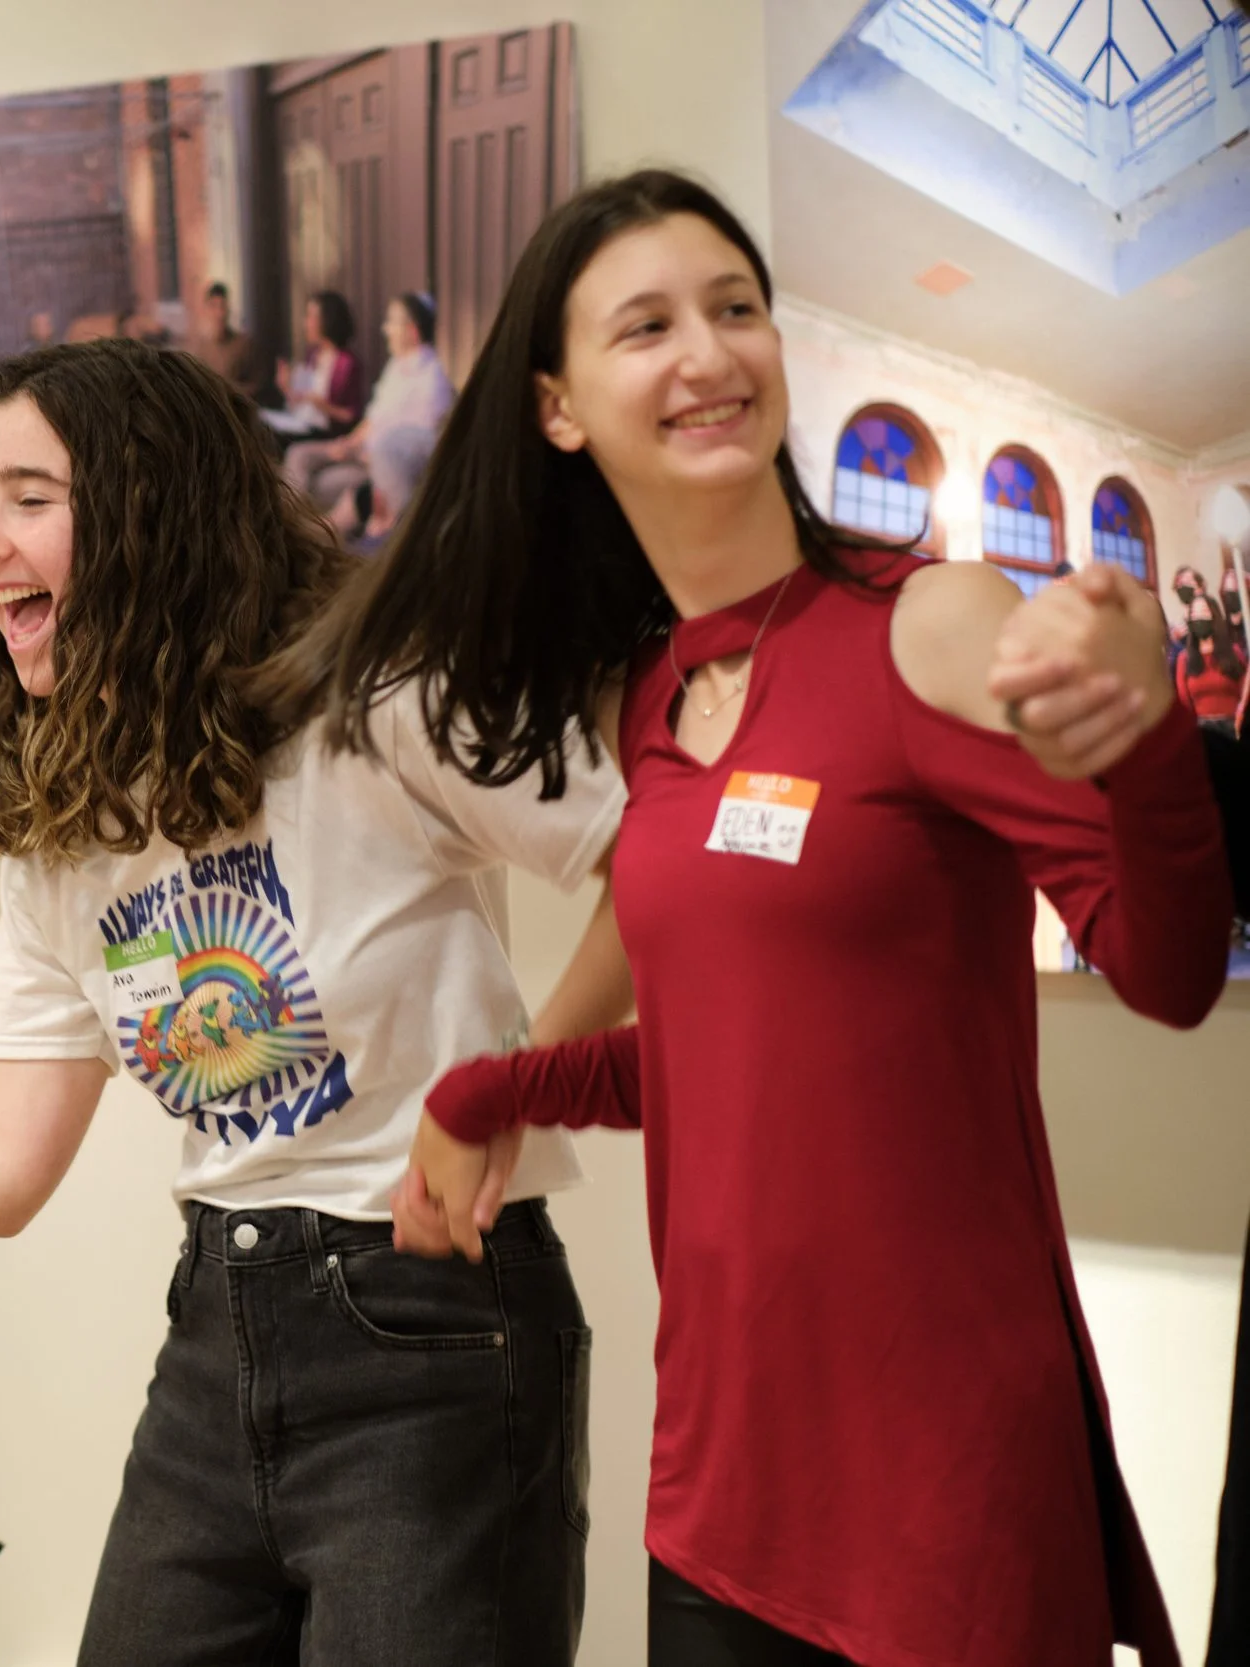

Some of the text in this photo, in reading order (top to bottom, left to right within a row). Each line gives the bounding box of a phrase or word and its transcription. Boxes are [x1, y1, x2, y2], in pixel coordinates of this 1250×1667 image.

[746, 774, 793, 794] HELLO
[98, 878, 166, 945] ALWAYS
[190, 837, 296, 930] GRATEFUL
[121, 935, 157, 958] HELLO
[113, 972, 135, 990] Ava
